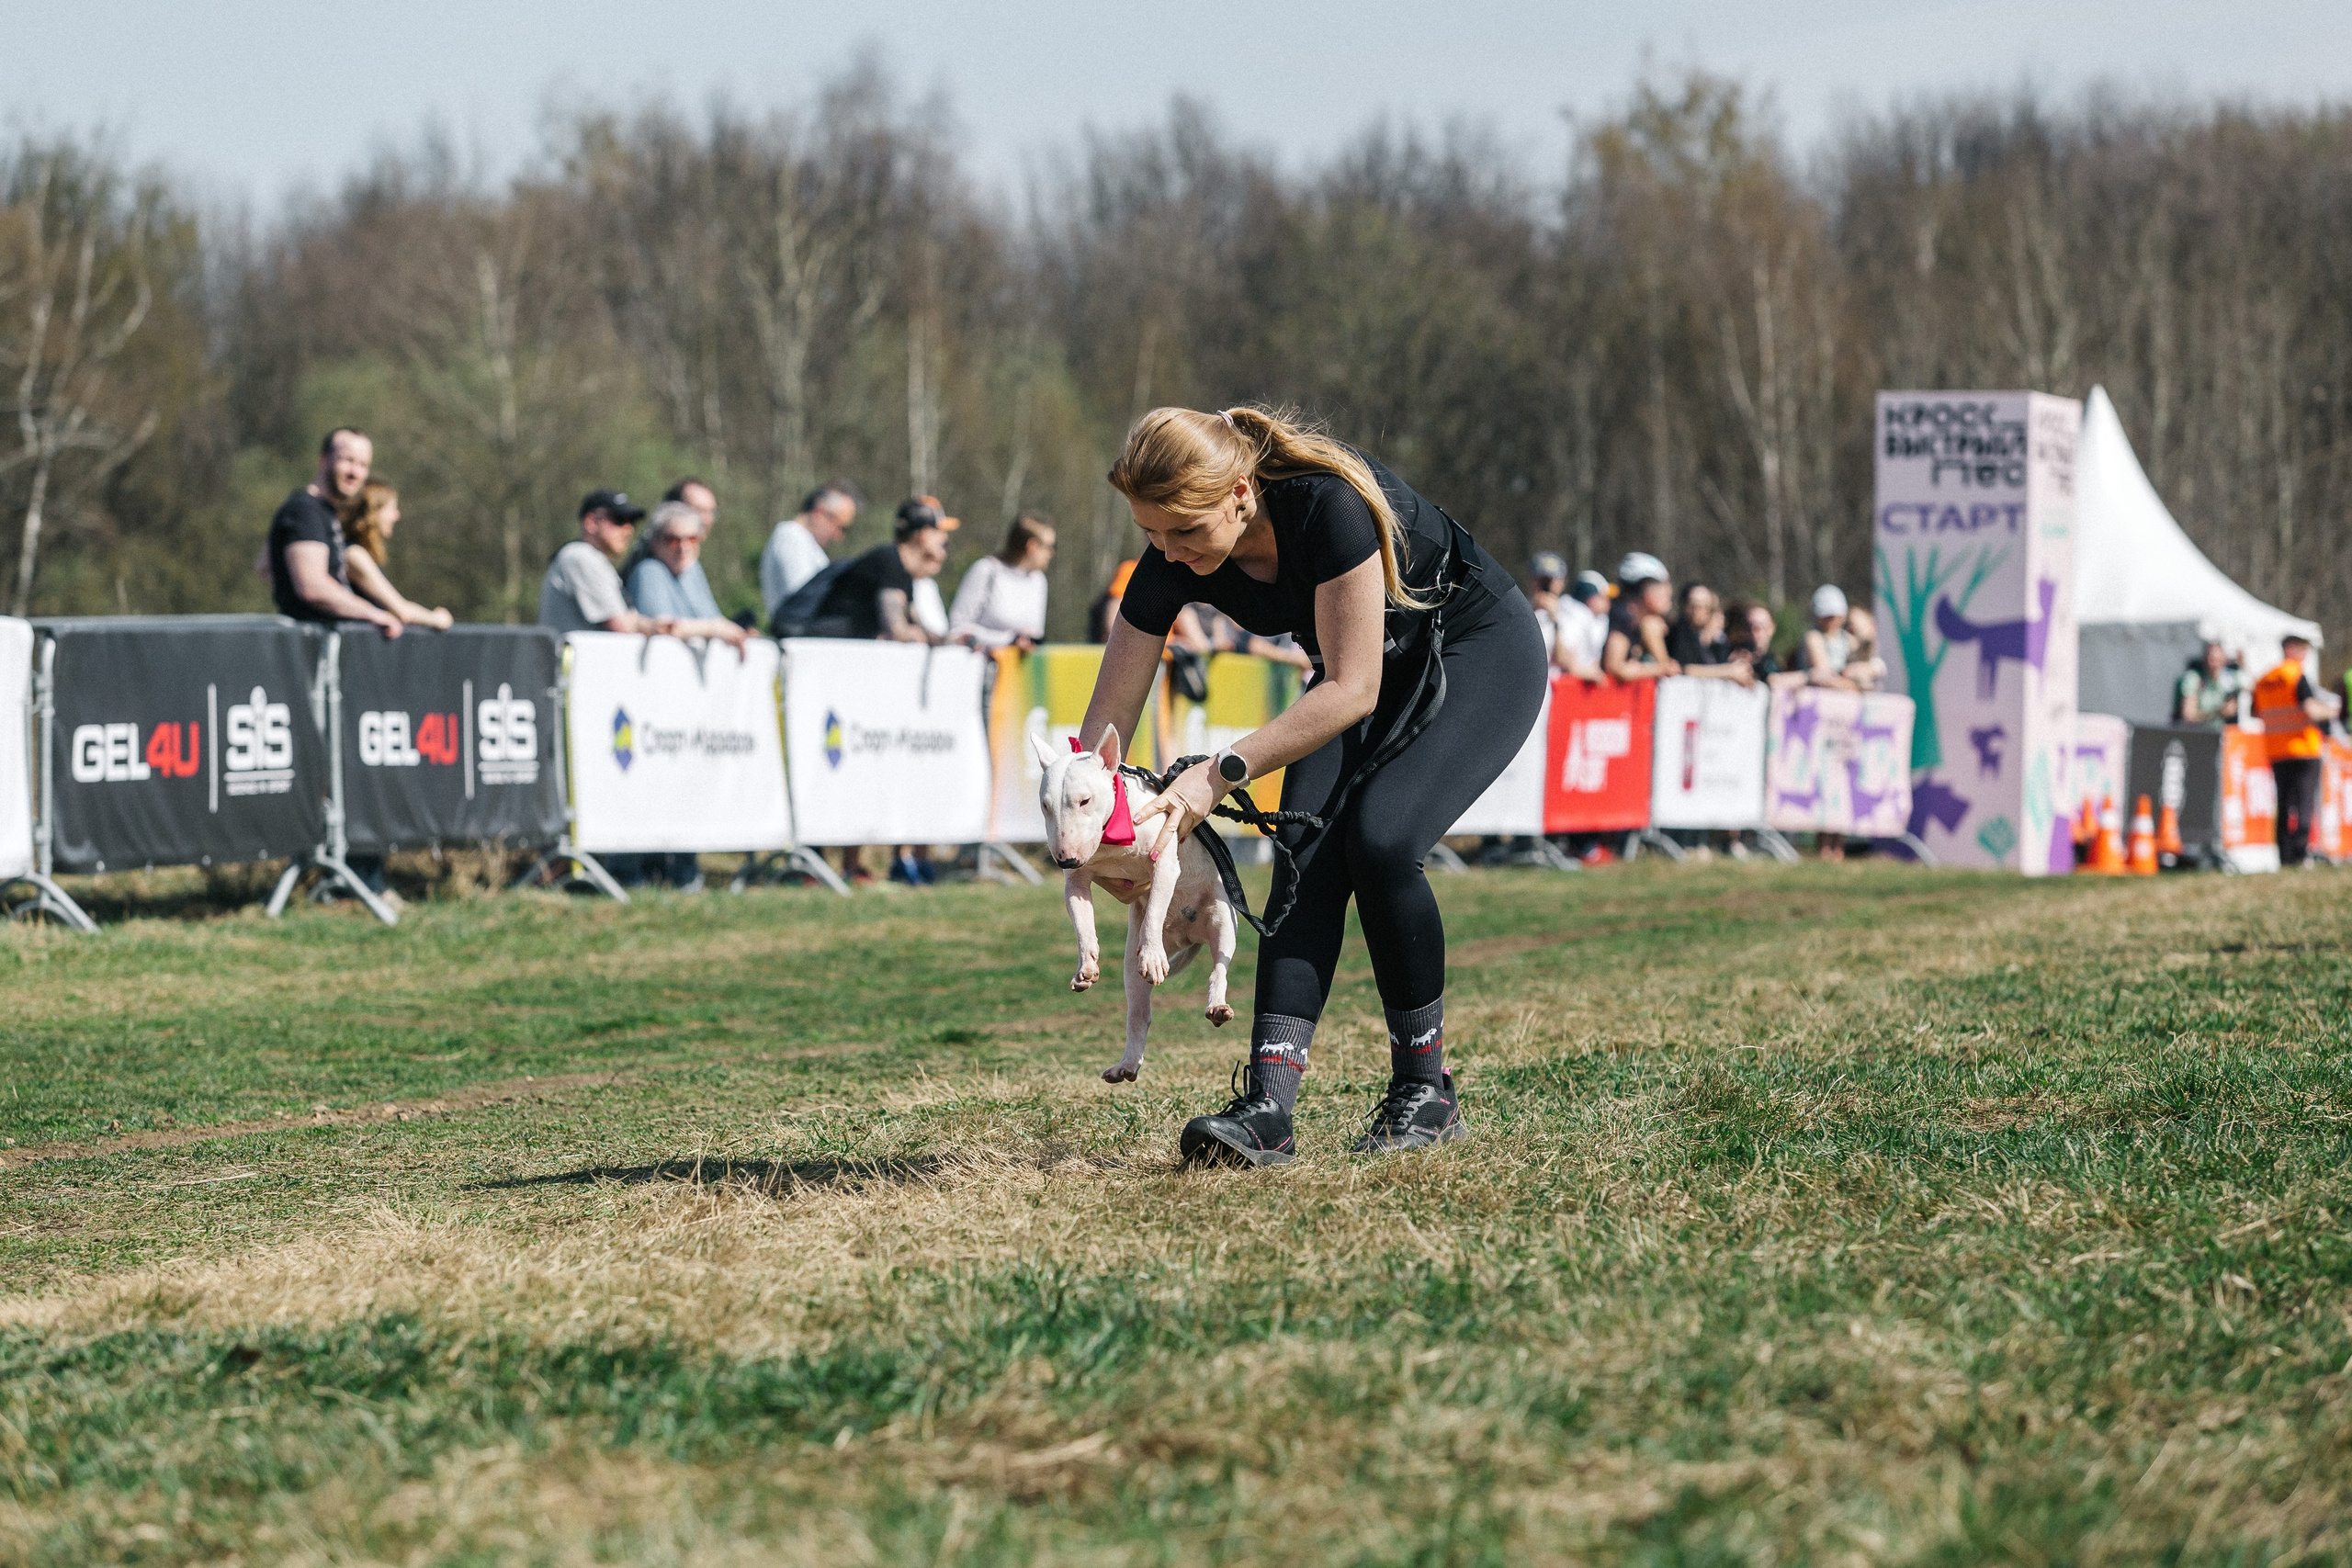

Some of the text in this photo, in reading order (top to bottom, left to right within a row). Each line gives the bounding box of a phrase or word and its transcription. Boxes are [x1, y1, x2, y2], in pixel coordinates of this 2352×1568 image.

[1883, 503, 2027, 535] СТАРТ
[72, 721, 200, 783] GEL4U
[359, 711, 458, 766] GEL4U
